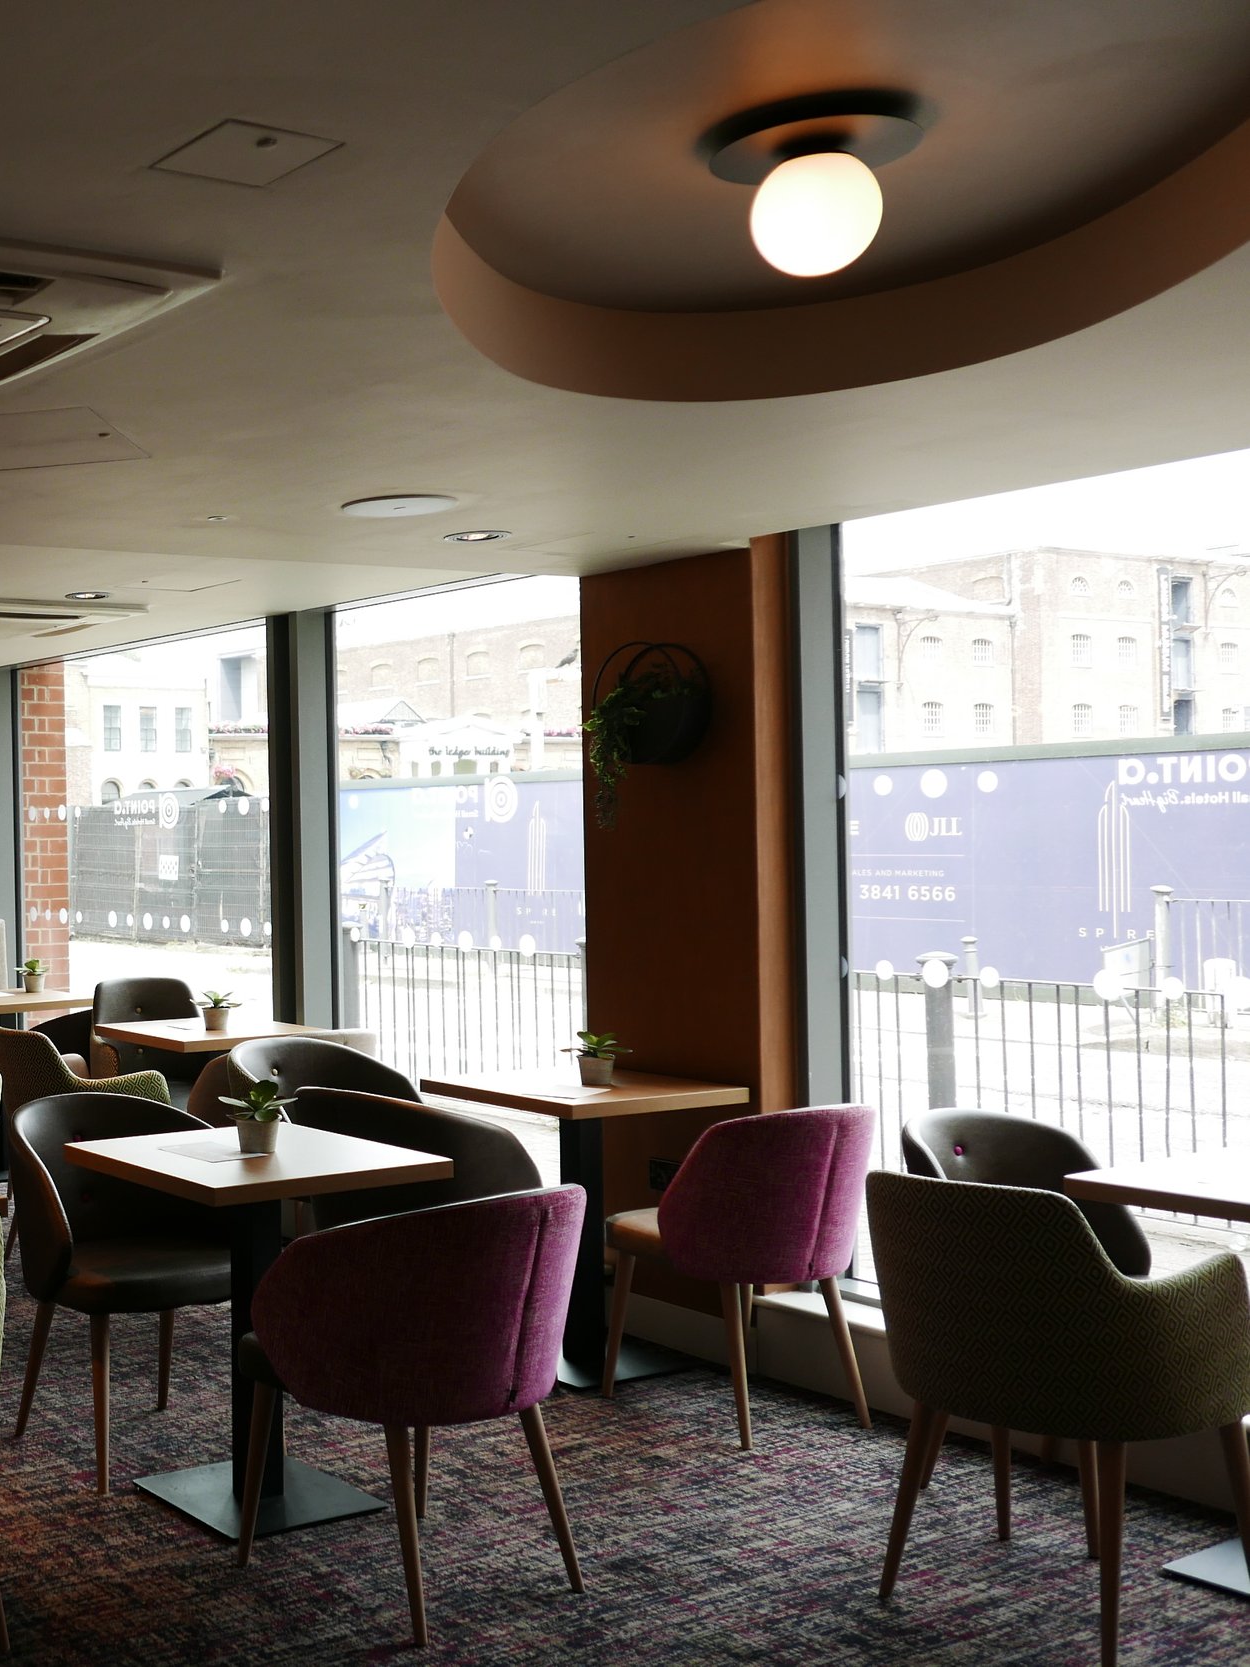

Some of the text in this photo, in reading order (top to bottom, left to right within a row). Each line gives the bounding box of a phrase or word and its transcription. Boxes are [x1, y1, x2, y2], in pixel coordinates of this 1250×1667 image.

[428, 745, 510, 759] the ledger building
[849, 816, 963, 837] E JLL
[851, 868, 945, 878] ALES AND MARKETING
[859, 884, 956, 902] 3841 6566
